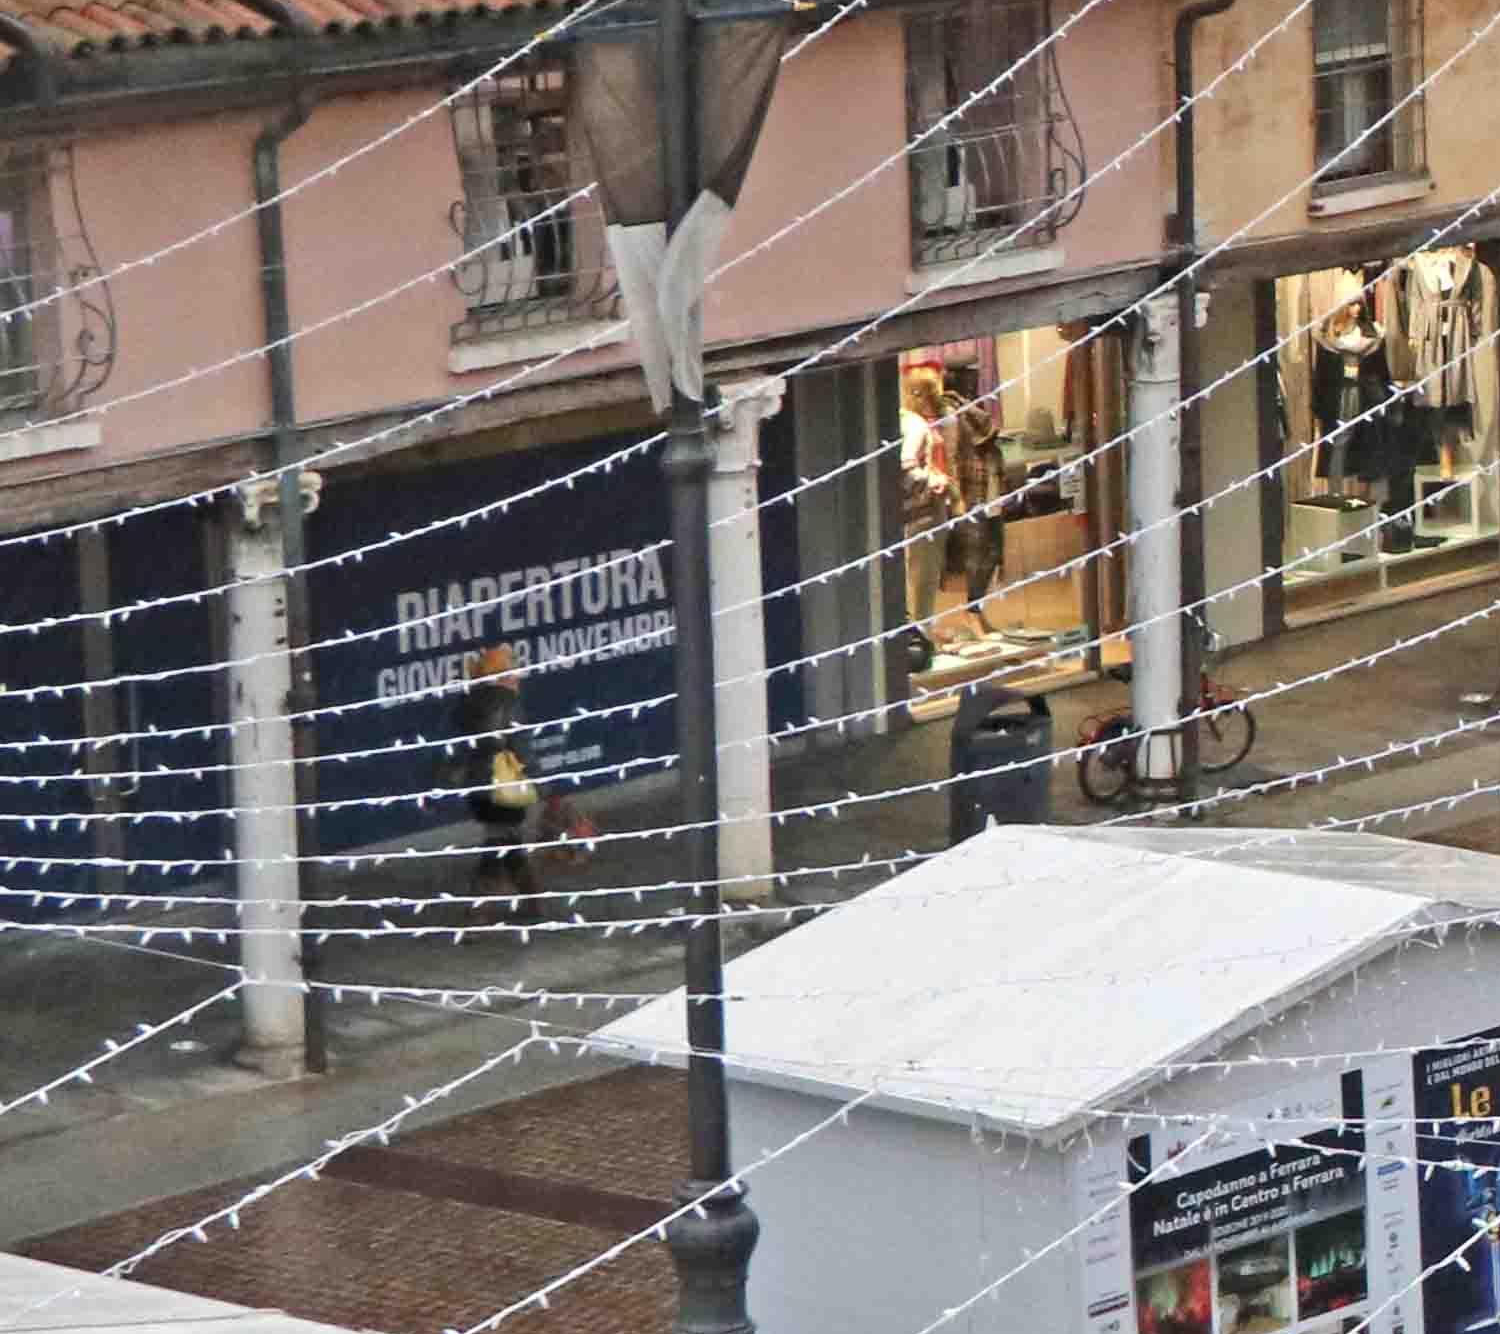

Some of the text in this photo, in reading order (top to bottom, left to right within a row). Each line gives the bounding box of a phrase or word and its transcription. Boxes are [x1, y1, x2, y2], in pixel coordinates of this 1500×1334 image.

[396, 547, 668, 654] RIAPERTURA
[377, 650, 481, 709] GIOVED
[537, 609, 677, 674] NOVEMBR
[1451, 1080, 1491, 1118] Le
[1153, 1210, 1202, 1238] Natale
[1214, 1199, 1229, 1219] in
[1231, 1186, 1279, 1212] Centro
[1282, 1182, 1290, 1197] a
[1292, 1166, 1345, 1192] Ferrara
[1176, 1169, 1257, 1210] Capodanno
[1269, 1153, 1321, 1181] Ferrara
